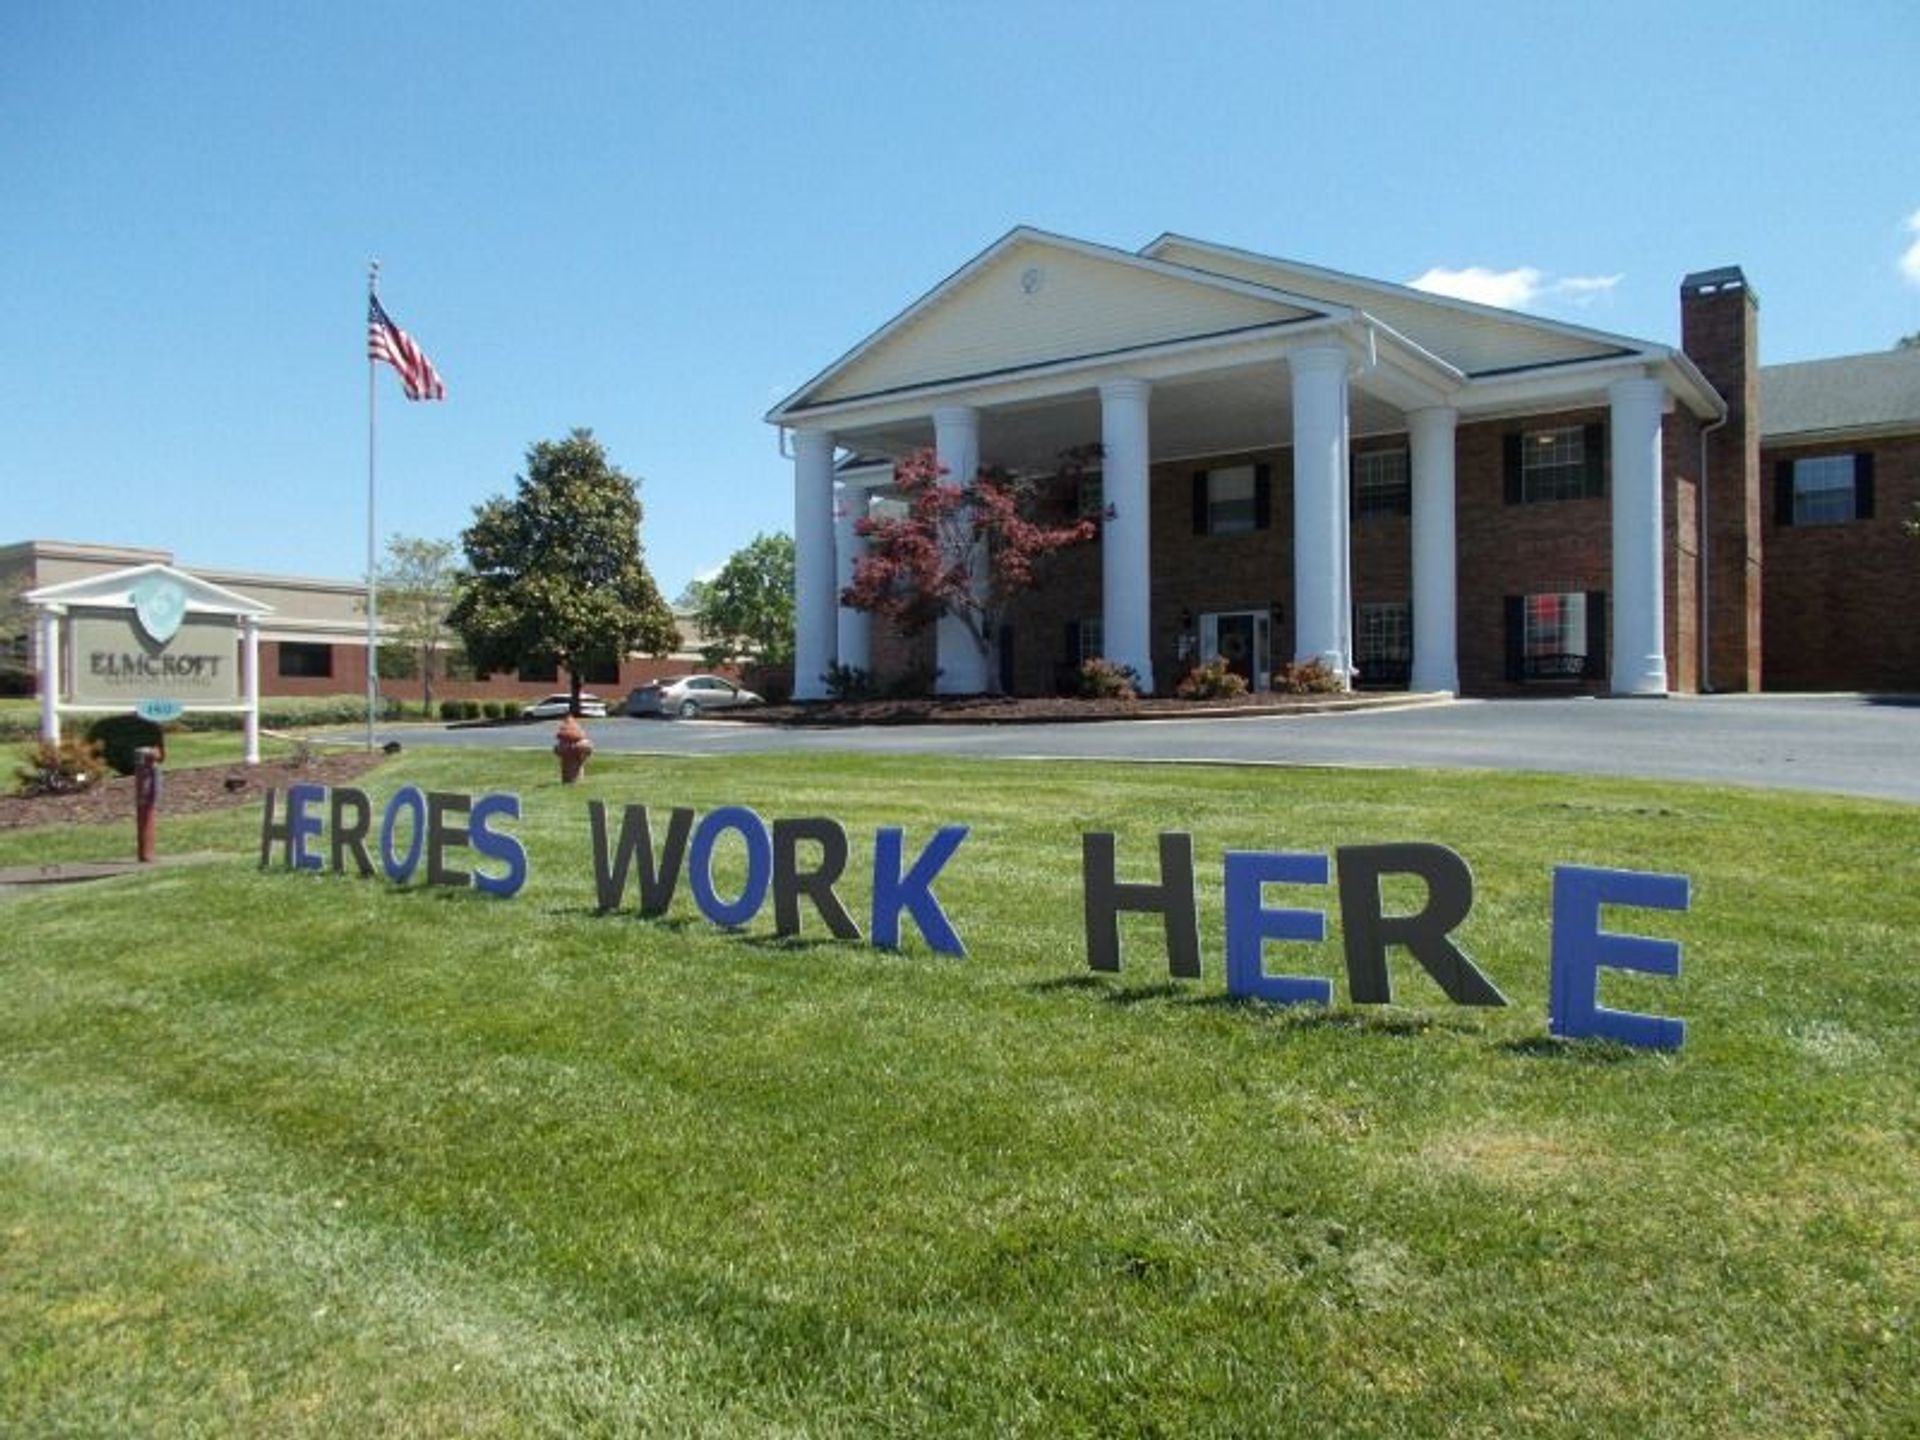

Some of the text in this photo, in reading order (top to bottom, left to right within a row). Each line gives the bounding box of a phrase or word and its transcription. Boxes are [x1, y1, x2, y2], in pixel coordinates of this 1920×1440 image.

[91, 652, 221, 676] ELMCROFT
[260, 784, 1690, 1051] HEROES WORK HERE
